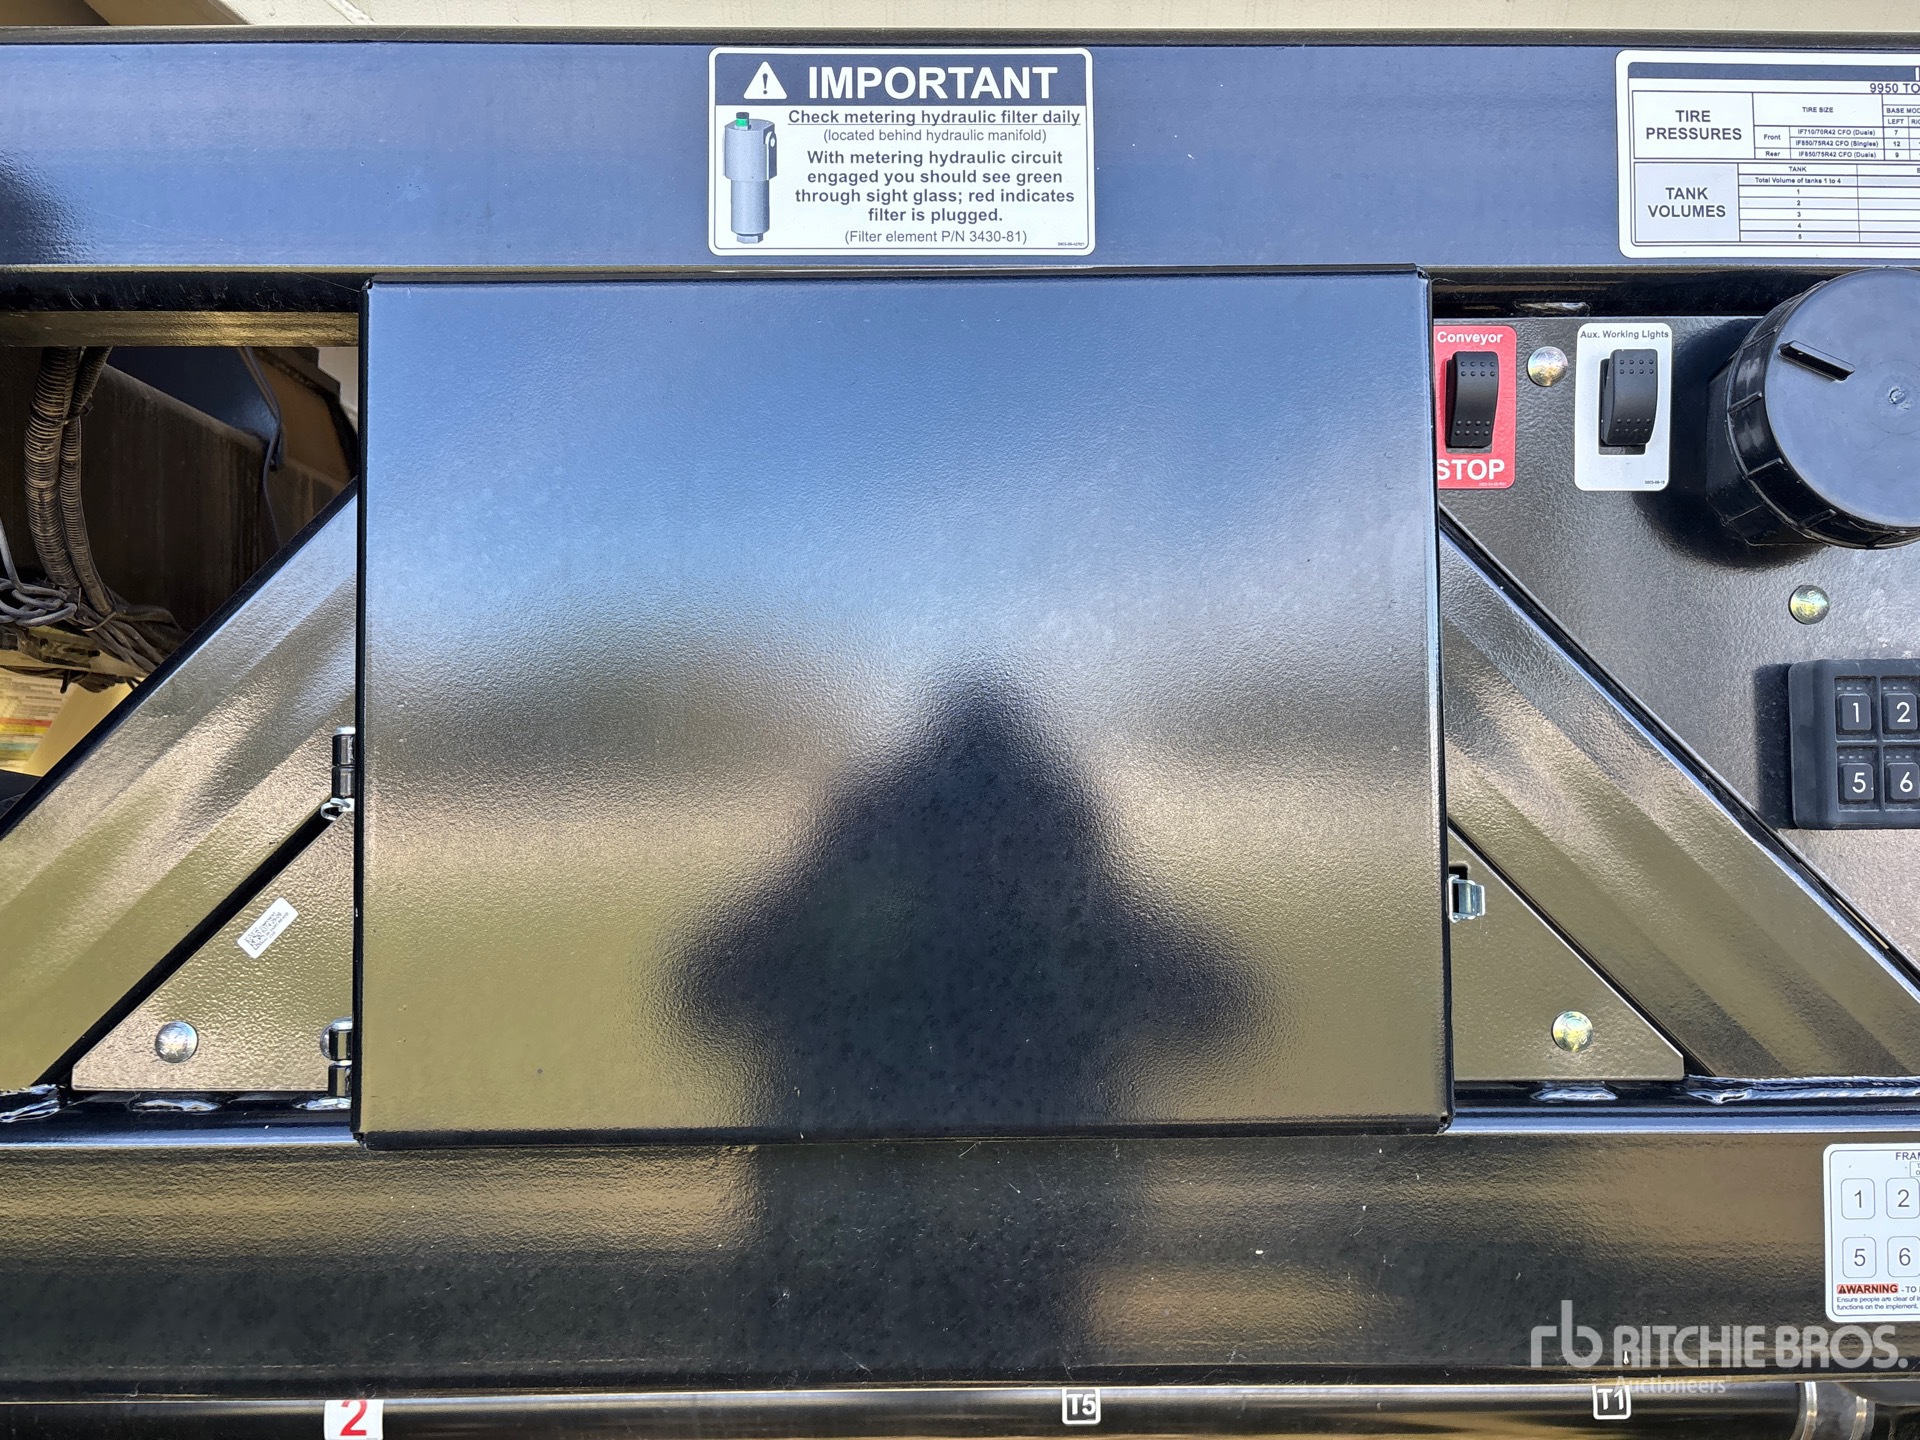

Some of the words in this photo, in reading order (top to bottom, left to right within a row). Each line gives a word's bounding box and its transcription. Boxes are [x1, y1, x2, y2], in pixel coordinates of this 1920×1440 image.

[808, 66, 1058, 100] IMPORTANT
[1870, 83, 1899, 94] 9950
[788, 110, 841, 124] Check
[844, 110, 916, 126] metering
[921, 110, 997, 126] hydraulic
[1000, 110, 1040, 124] filter
[1043, 110, 1081, 126] daily
[1675, 110, 1711, 123] TIRE
[823, 129, 875, 143] (located
[878, 129, 922, 142] behind
[926, 129, 984, 143] hydraulic
[988, 129, 1047, 143] manifold)
[1646, 127, 1742, 141] PRESSURES
[1851, 140, 1879, 148] (Singles)
[807, 150, 845, 165] With
[849, 150, 923, 167] metering
[928, 150, 1006, 167] hydraulic
[1010, 150, 1063, 165] circuit
[1854, 151, 1876, 159] (Duals)
[807, 169, 879, 186] engaged
[883, 171, 916, 186] you
[920, 169, 977, 184] should
[982, 171, 1011, 184] see
[1015, 171, 1063, 186] green
[795, 189, 861, 205] through
[866, 189, 908, 205] sight
[913, 189, 962, 205] glass;
[968, 189, 995, 203] red
[999, 189, 1075, 203] indicates
[1665, 187, 1708, 200] TANK
[868, 208, 907, 222] filter
[911, 208, 926, 222] is
[930, 208, 1003, 224] plugged.
[1647, 204, 1726, 218] VOLUMES
[844, 230, 882, 245] (Filter
[885, 230, 937, 243] element
[941, 230, 965, 243] P/N
[969, 230, 1027, 245] 3430-81)
[1437, 331, 1503, 346] Conveyor
[1580, 330, 1600, 338] Aux.
[1602, 330, 1639, 339] Working
[1641, 330, 1669, 340] Lights
[1437, 458, 1505, 481] STOP
[1852, 702, 1860, 723] 1
[1896, 701, 1911, 723] 2
[1852, 772, 1866, 793] 5
[1899, 771, 1913, 793] 6
[1854, 1190, 1862, 1208] 1
[1897, 1189, 1910, 1208] 2
[1853, 1248, 1866, 1267] 5
[1899, 1248, 1911, 1266] 6
[1846, 1284, 1898, 1294] WARNING
[1066, 1394, 1096, 1415] T5
[1597, 1388, 1624, 1410] T1
[340, 1399, 368, 1436] 2
